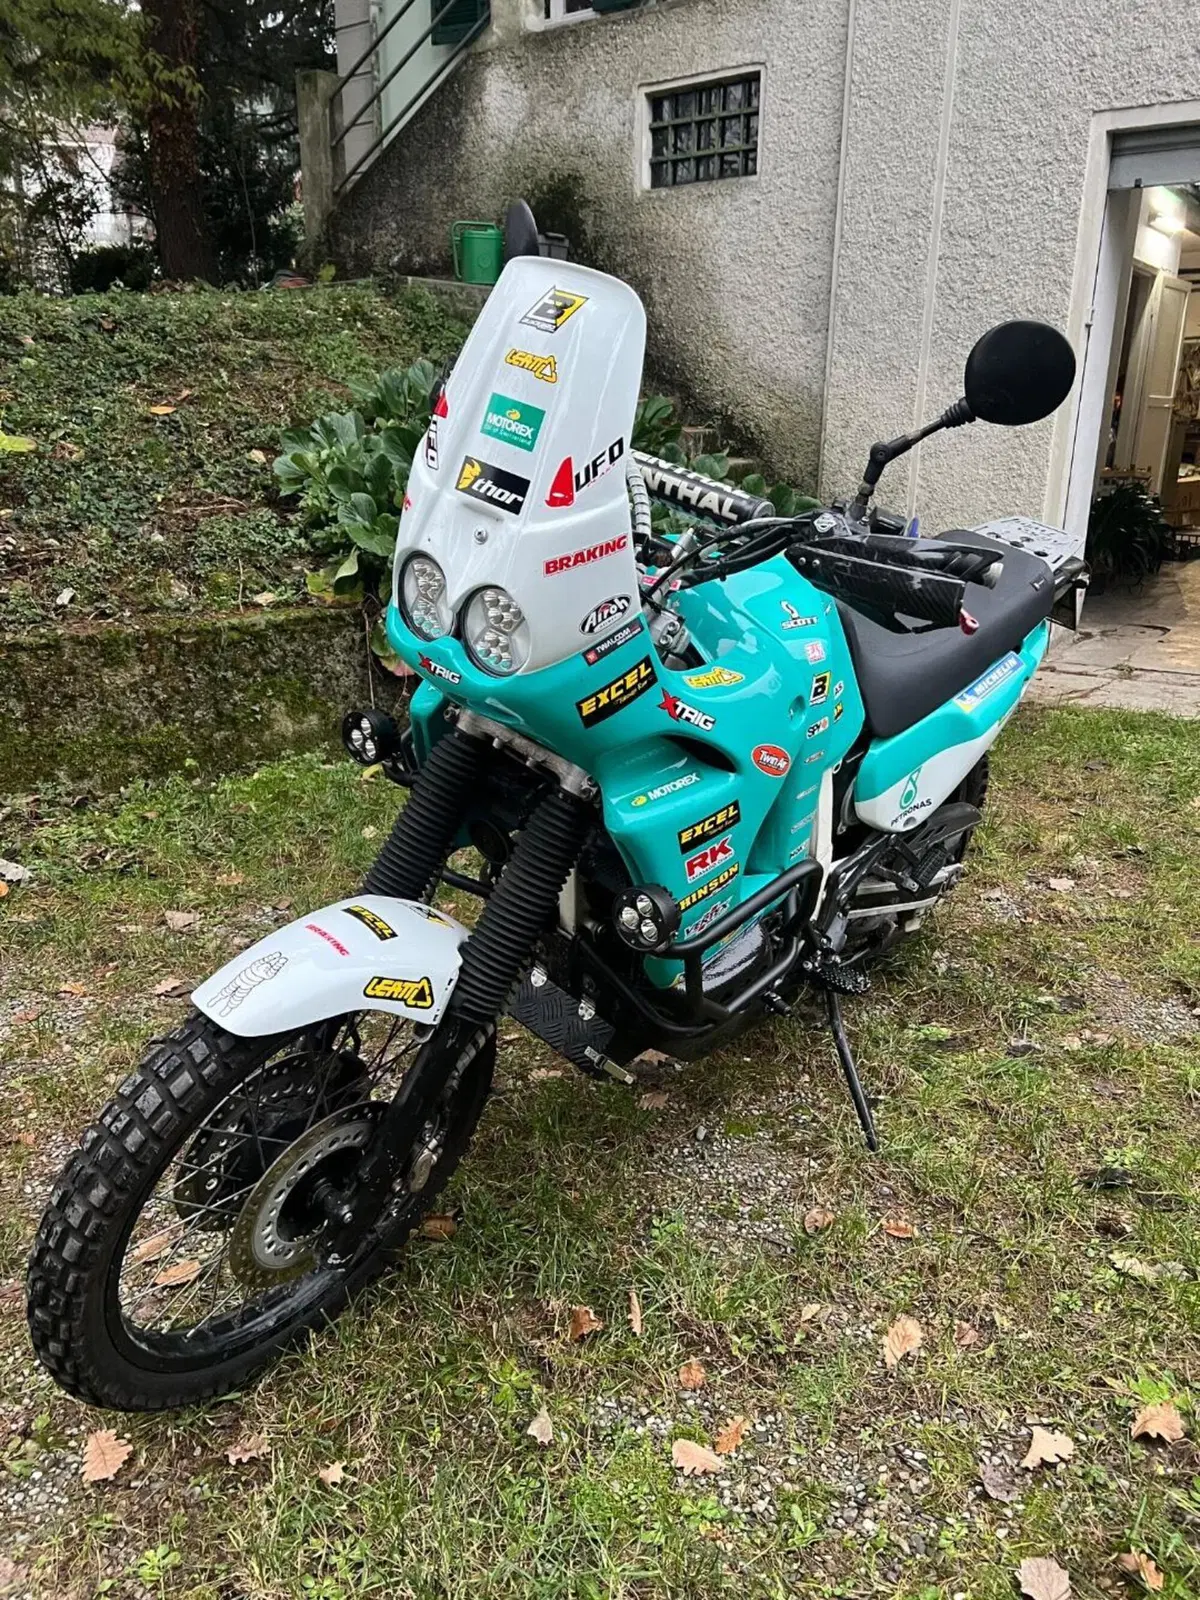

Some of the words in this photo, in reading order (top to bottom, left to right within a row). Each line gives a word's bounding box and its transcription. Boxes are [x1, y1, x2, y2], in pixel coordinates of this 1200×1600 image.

[486, 412, 534, 439] MOTOREX
[575, 437, 624, 492] UFO
[471, 476, 524, 506] thor
[545, 534, 628, 576] BRAKING
[584, 598, 629, 633] Airoh
[781, 616, 819, 630] SCOTT
[596, 627, 630, 653] TWALCOM
[418, 651, 461, 684] XTRIG
[973, 656, 1018, 695] MICHELIN
[580, 662, 652, 717] EXCEL
[812, 674, 828, 699] B
[657, 687, 716, 732] XTRIG
[647, 773, 701, 801] MOTOREX
[681, 804, 739, 845] EXCEL
[890, 798, 933, 828] PETRONAS
[688, 837, 733, 878] RK
[679, 862, 739, 911] HINSON
[349, 905, 392, 937] EXCEL
[305, 923, 350, 957] BRAKING
